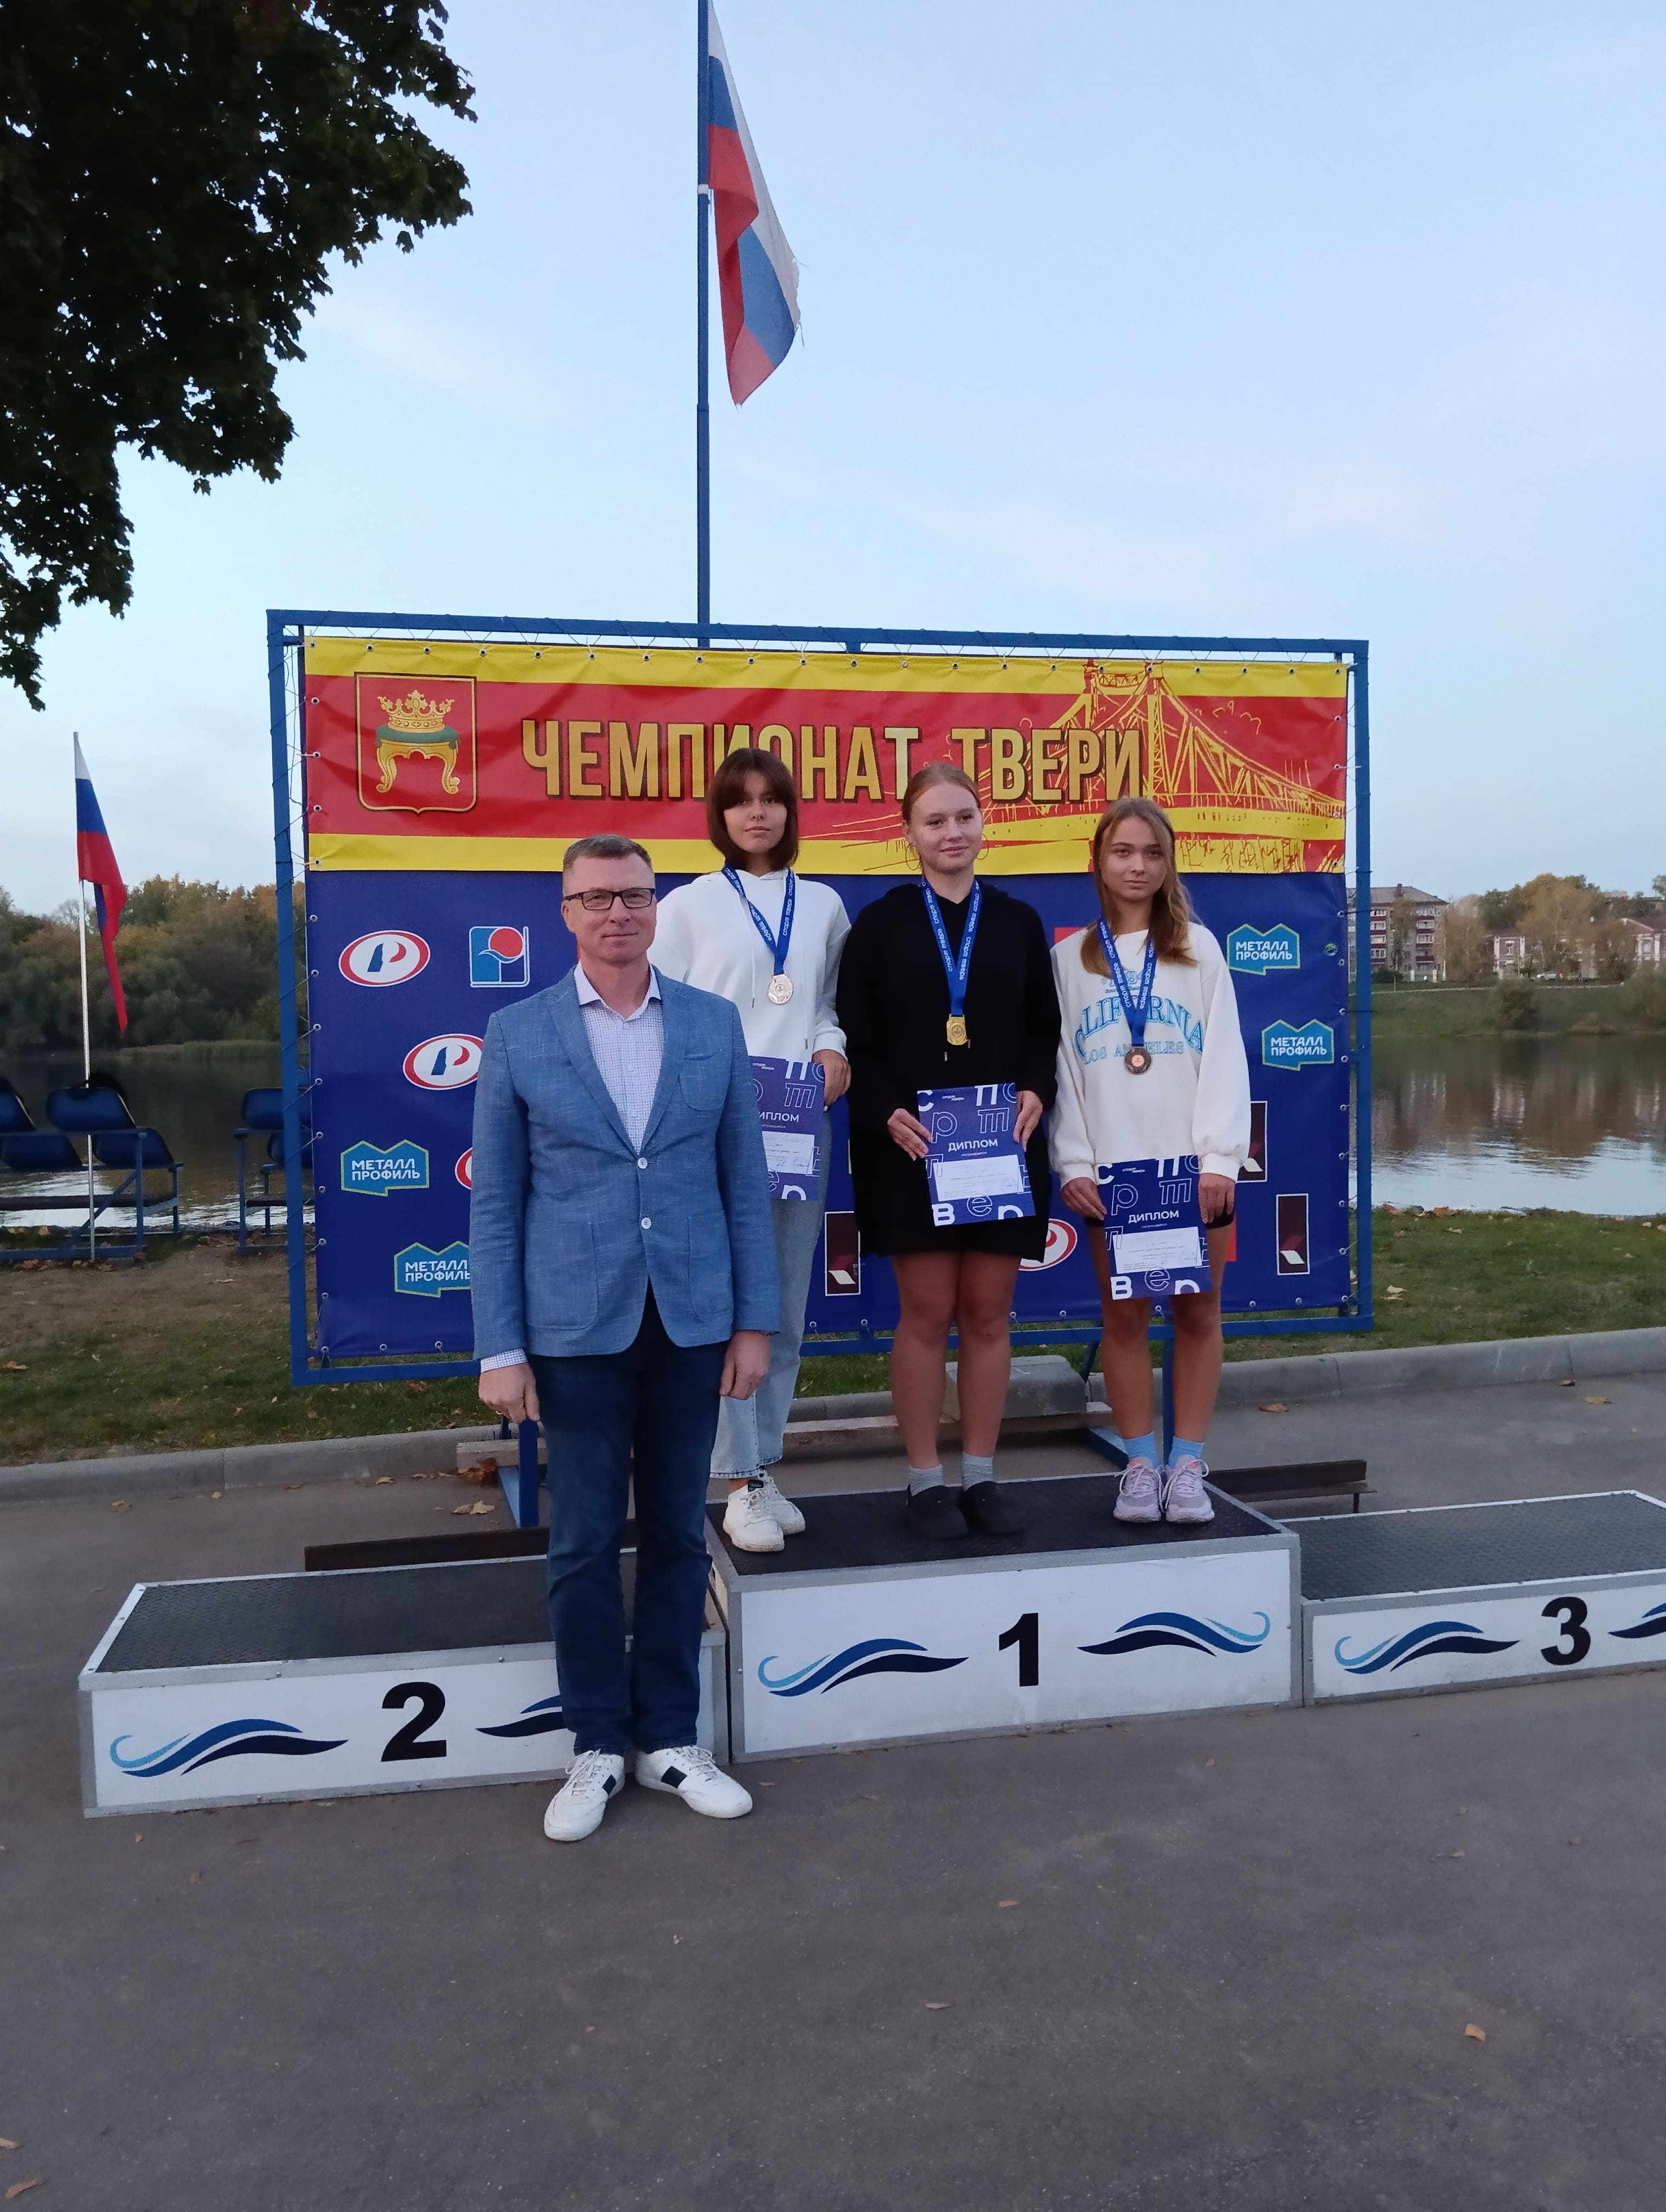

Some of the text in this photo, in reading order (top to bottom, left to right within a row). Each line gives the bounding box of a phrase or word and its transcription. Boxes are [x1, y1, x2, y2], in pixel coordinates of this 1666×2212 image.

[951, 728, 1142, 803] ТВЕРИ
[1235, 941, 1289, 951] МЕТАЛЛ
[1235, 951, 1293, 961] ПРОФИЛЬ
[1075, 996, 1203, 1060] CLIFRNIA
[1271, 1036, 1323, 1047] МЕТАЛЛ
[1271, 1046, 1328, 1056] ПРОФИЛЬ
[759, 1111, 800, 1123] ИПЛОМ
[948, 1139, 998, 1153] ДИПЛОМ
[351, 1159, 415, 1171] МЕТАЛЛ
[351, 1169, 421, 1181] ПРОФИЛЬ
[1128, 1210, 1180, 1224] ДИПЛОМ
[405, 1259, 468, 1272] МЕТАЛЛ
[1540, 1596, 1591, 1666] 3
[998, 1612, 1039, 1687] 1
[381, 1681, 447, 1763] 2
